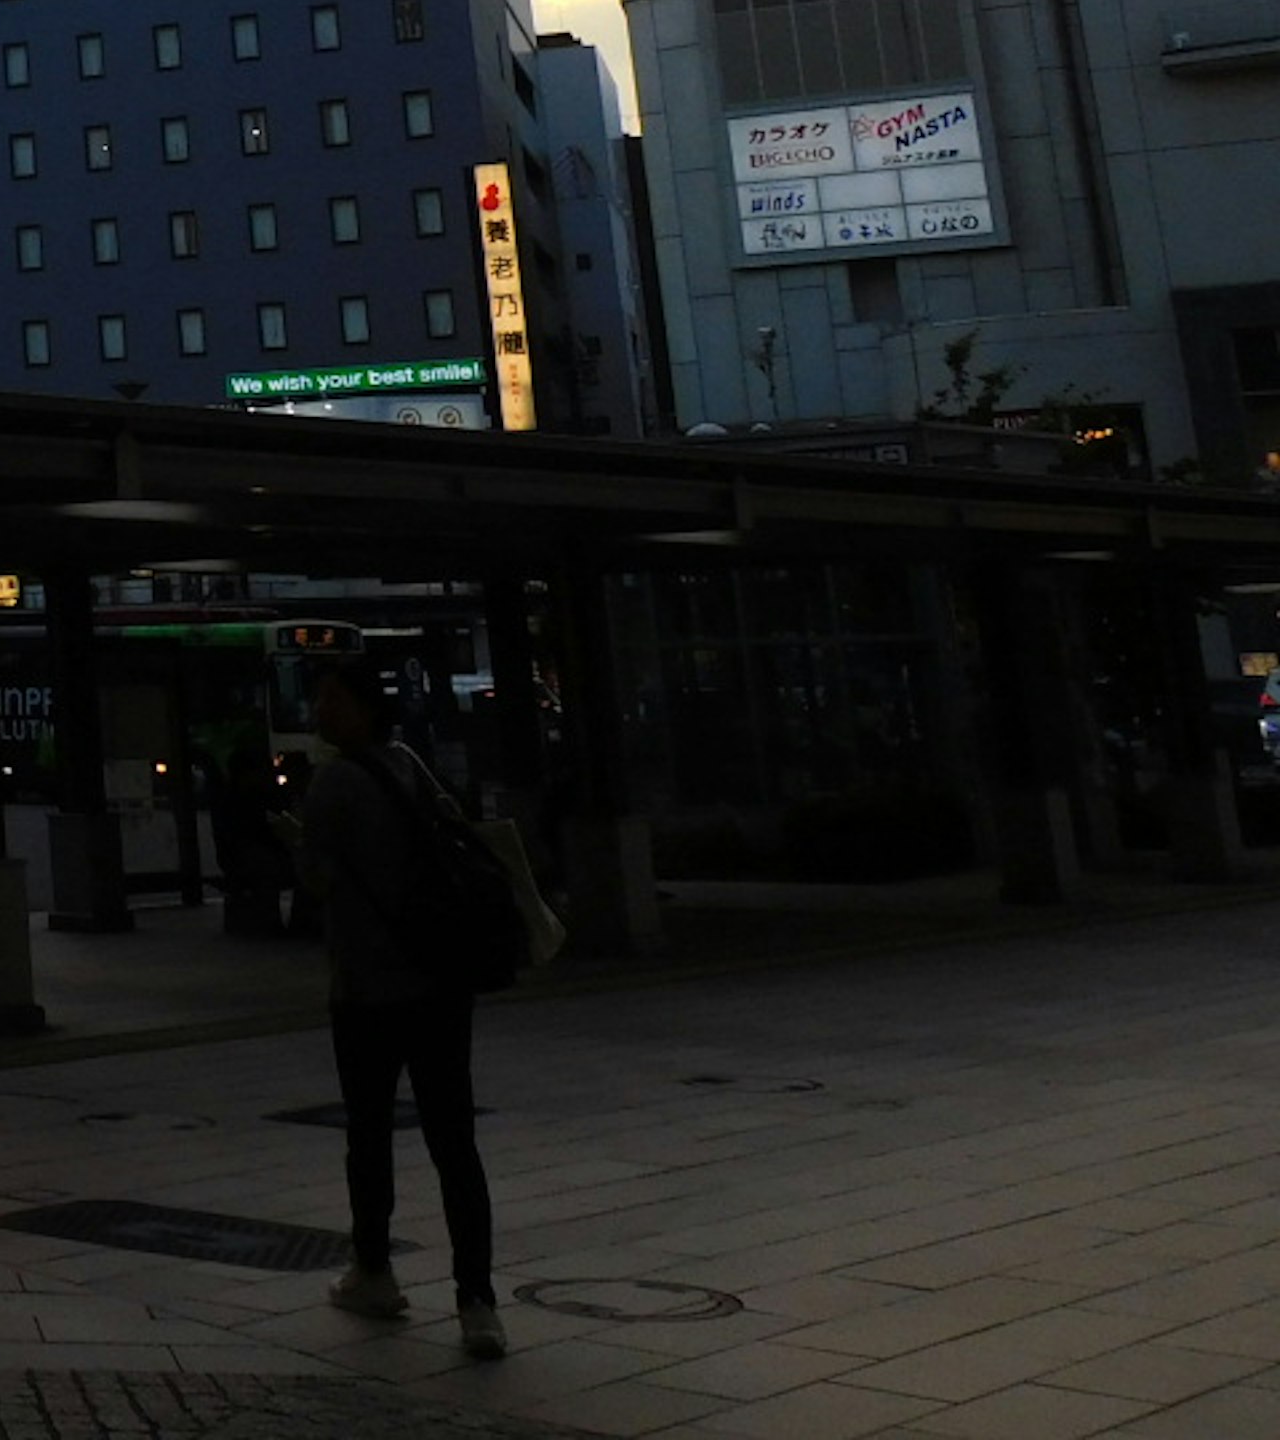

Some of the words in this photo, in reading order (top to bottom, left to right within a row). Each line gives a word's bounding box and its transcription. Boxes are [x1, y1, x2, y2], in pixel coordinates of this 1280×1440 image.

[749, 121, 831, 145] カラオケ
[877, 104, 925, 138] GYM
[895, 106, 967, 151] NASTA
[231, 375, 262, 394] We
[268, 373, 312, 392] wish
[316, 371, 363, 393] your
[367, 366, 414, 386] best
[420, 361, 481, 384] smile!
